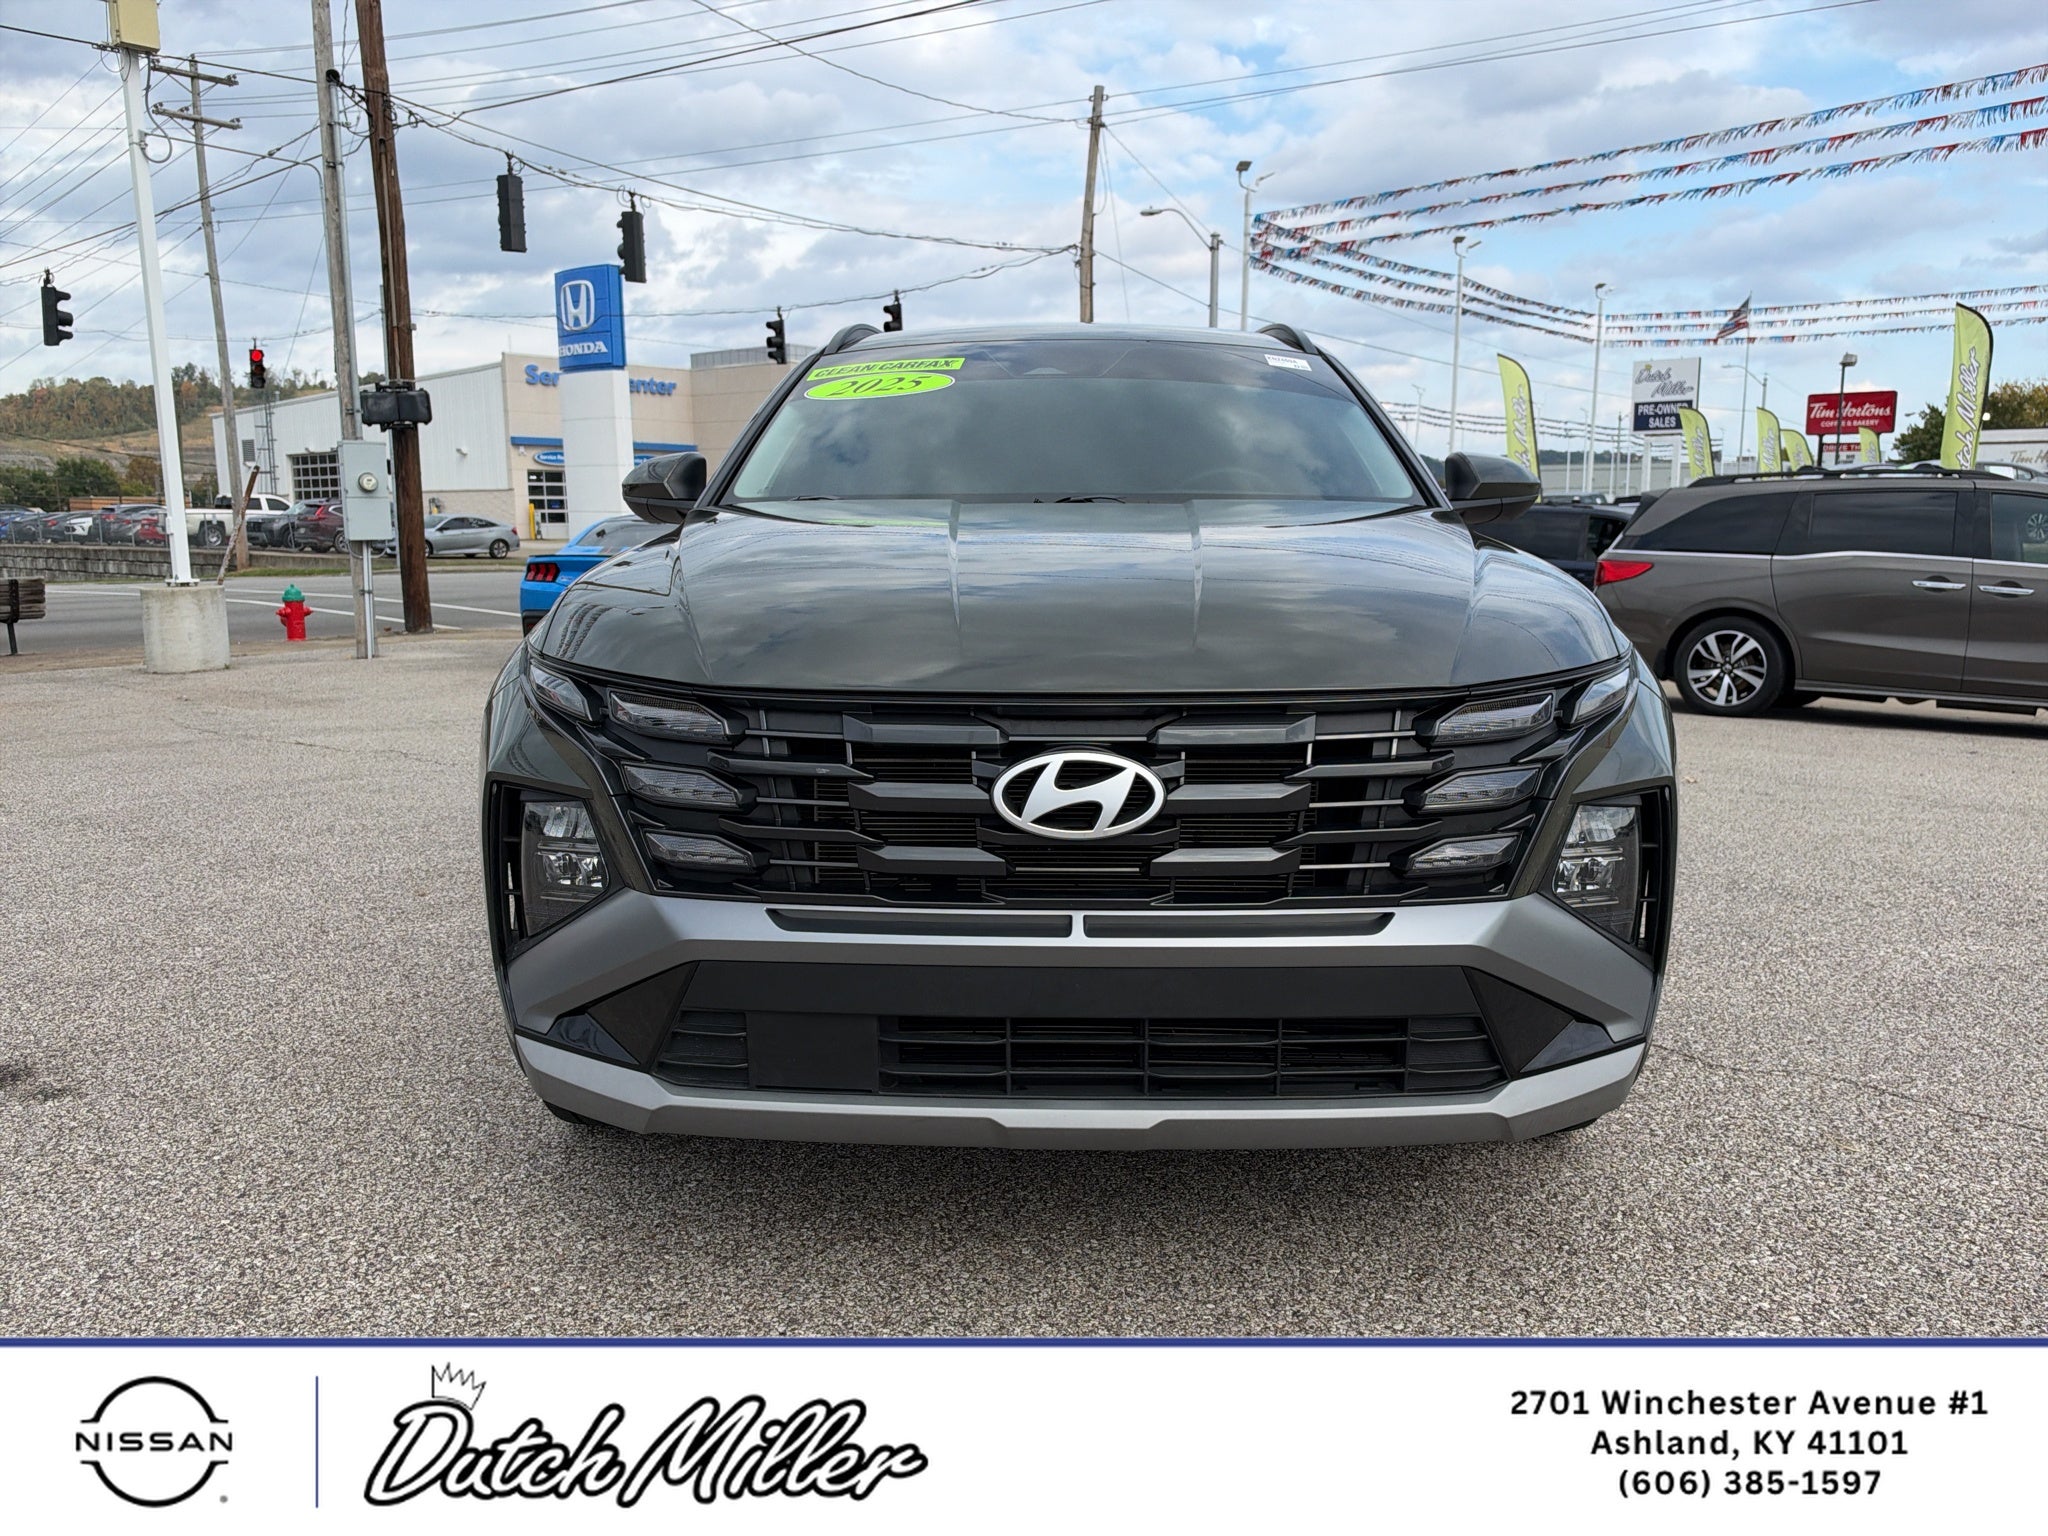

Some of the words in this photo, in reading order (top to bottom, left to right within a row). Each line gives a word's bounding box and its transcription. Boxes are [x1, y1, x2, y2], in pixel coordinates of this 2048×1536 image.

[559, 341, 608, 356] HONDA
[814, 363, 877, 378] CLEAN
[878, 359, 959, 371] CARFAX
[630, 377, 677, 396] enter
[826, 375, 932, 397] 2025
[1956, 346, 1980, 431] Miller
[1809, 402, 1835, 419] Tim
[1648, 416, 1676, 428] SALES
